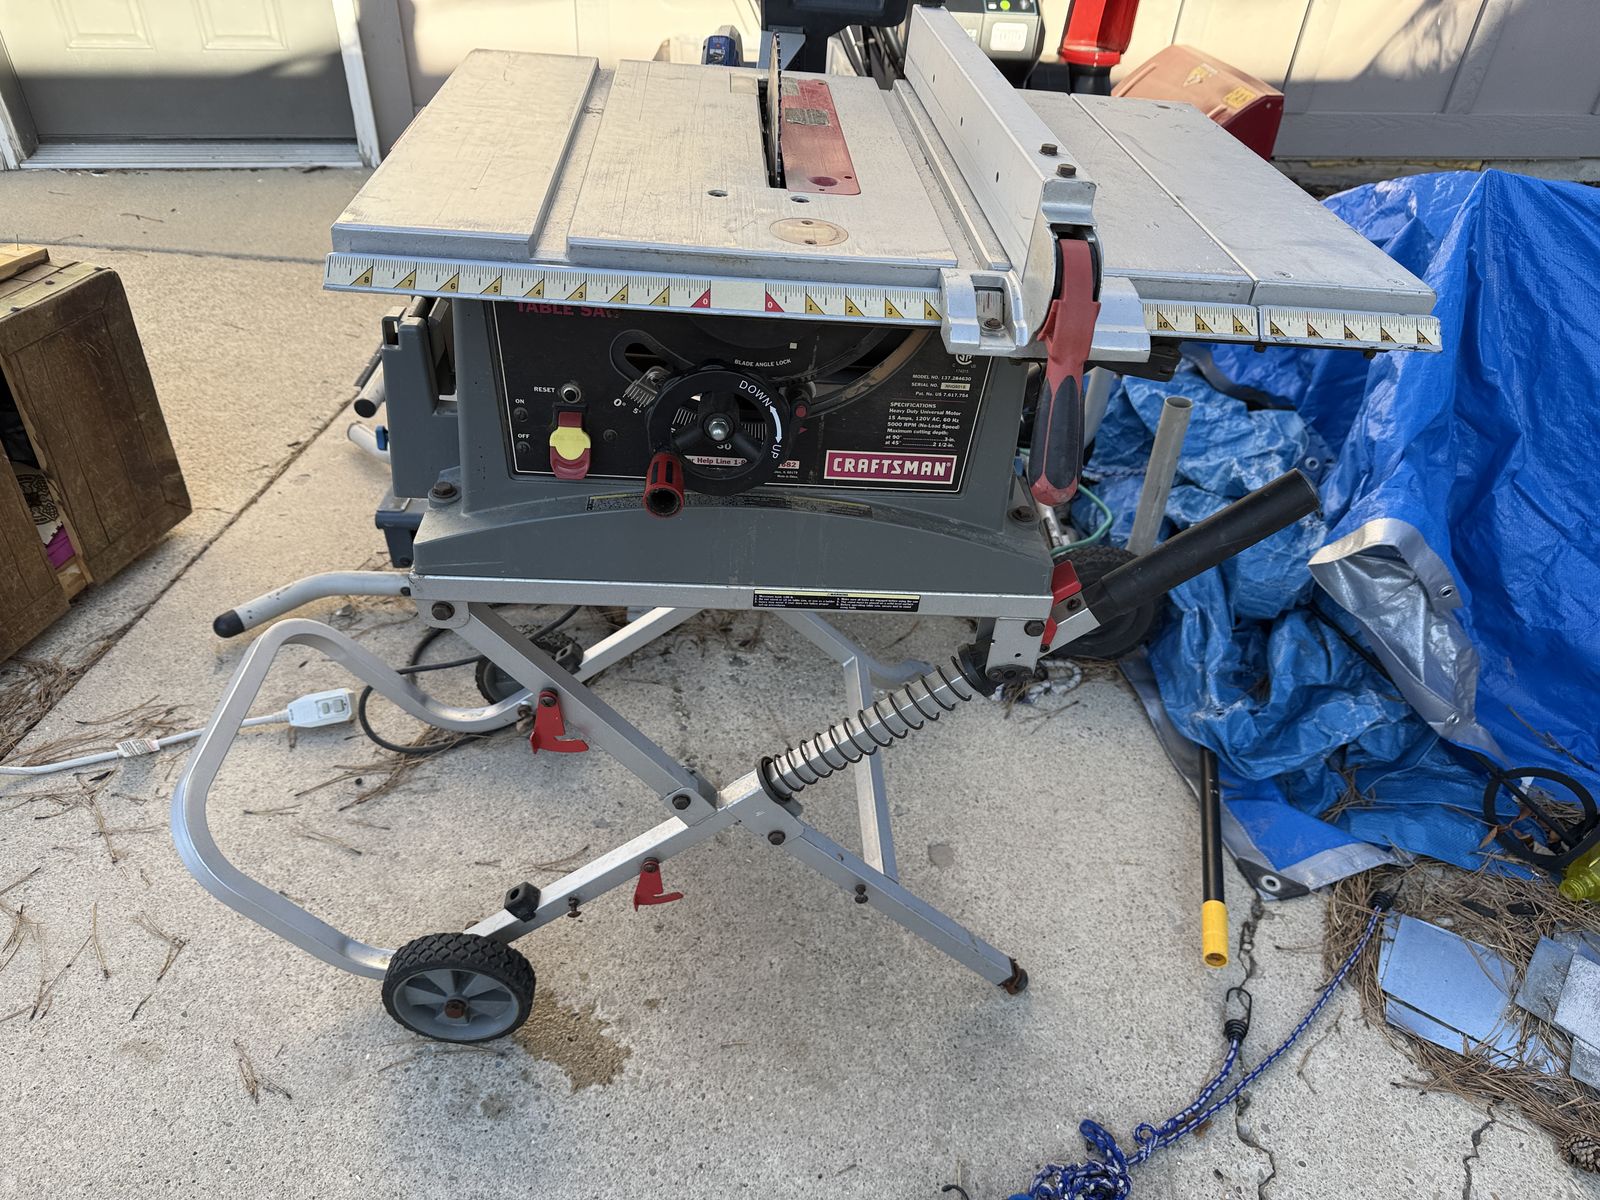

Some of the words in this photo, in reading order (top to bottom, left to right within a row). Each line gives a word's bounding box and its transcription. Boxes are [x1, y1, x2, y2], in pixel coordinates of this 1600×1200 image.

[364, 276, 370, 284] 8
[407, 279, 413, 287] 7
[518, 302, 574, 316] TABLE
[739, 380, 772, 407] DOWN
[771, 444, 781, 458] UP
[832, 457, 946, 476] CRAFTSMAN
